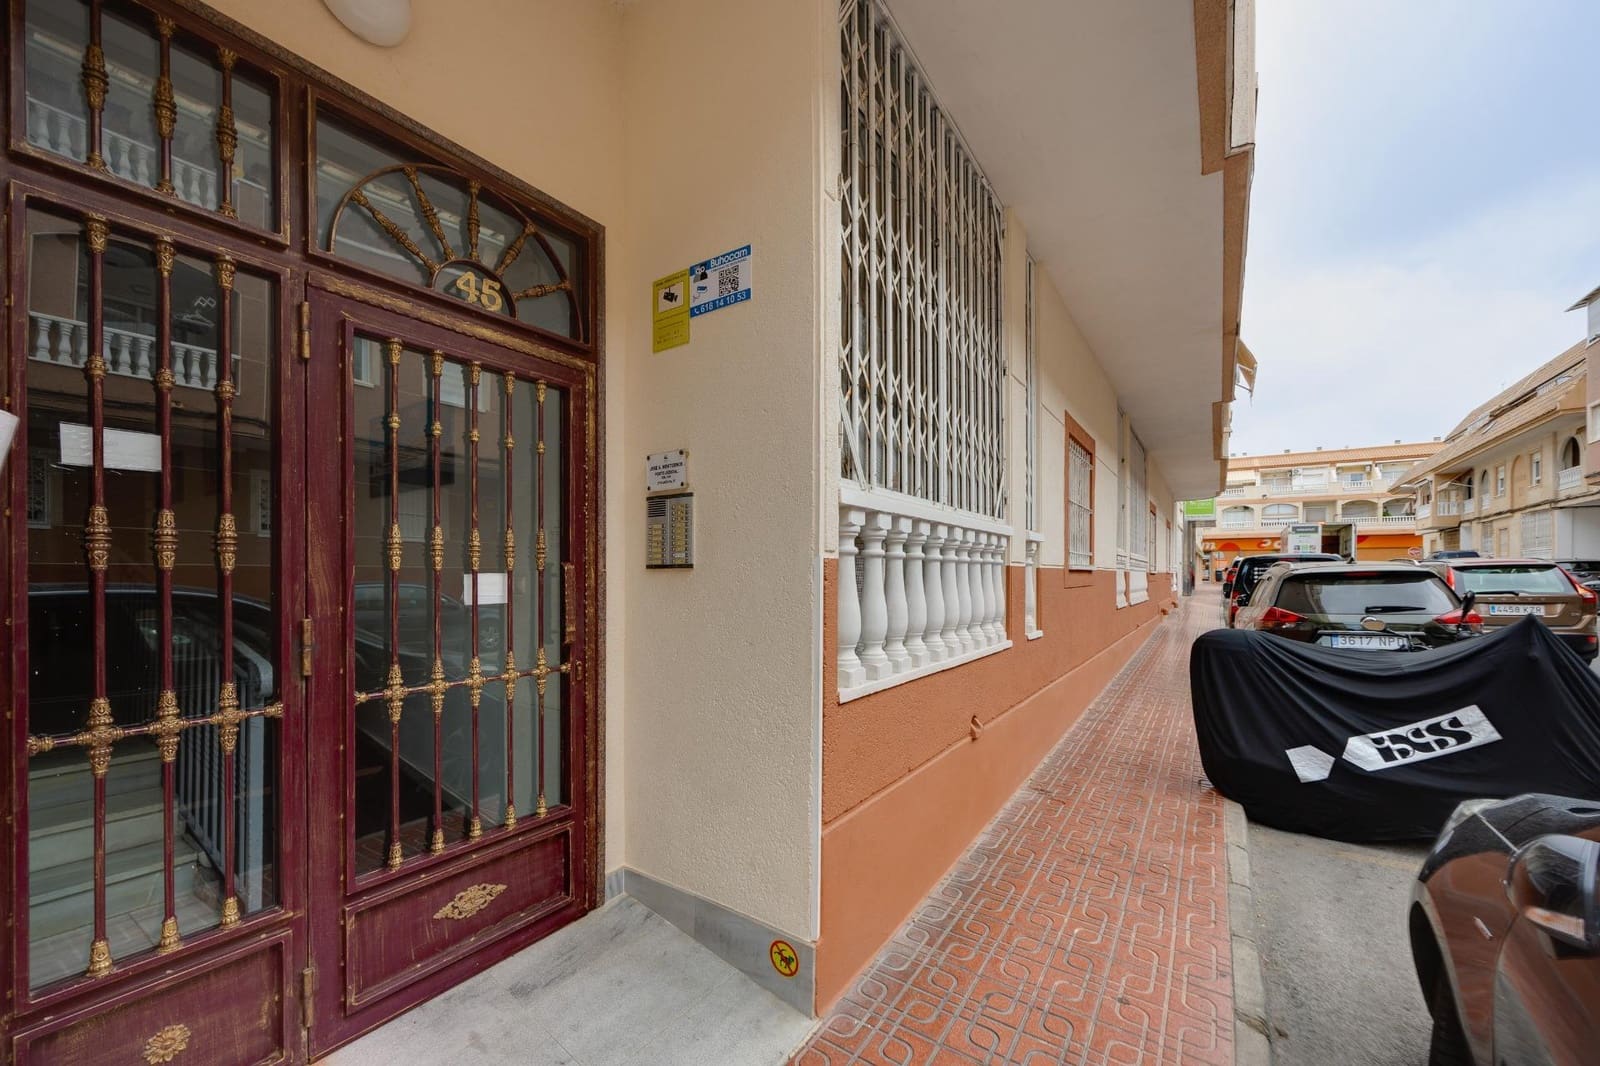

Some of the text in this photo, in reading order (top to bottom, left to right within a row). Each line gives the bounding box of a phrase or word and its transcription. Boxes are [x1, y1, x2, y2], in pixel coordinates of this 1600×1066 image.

[710, 248, 748, 268] Buhocam
[456, 271, 503, 311] 45
[727, 296, 735, 305] 10
[737, 292, 747, 301] 53
[1340, 636, 1373, 646] 3617
